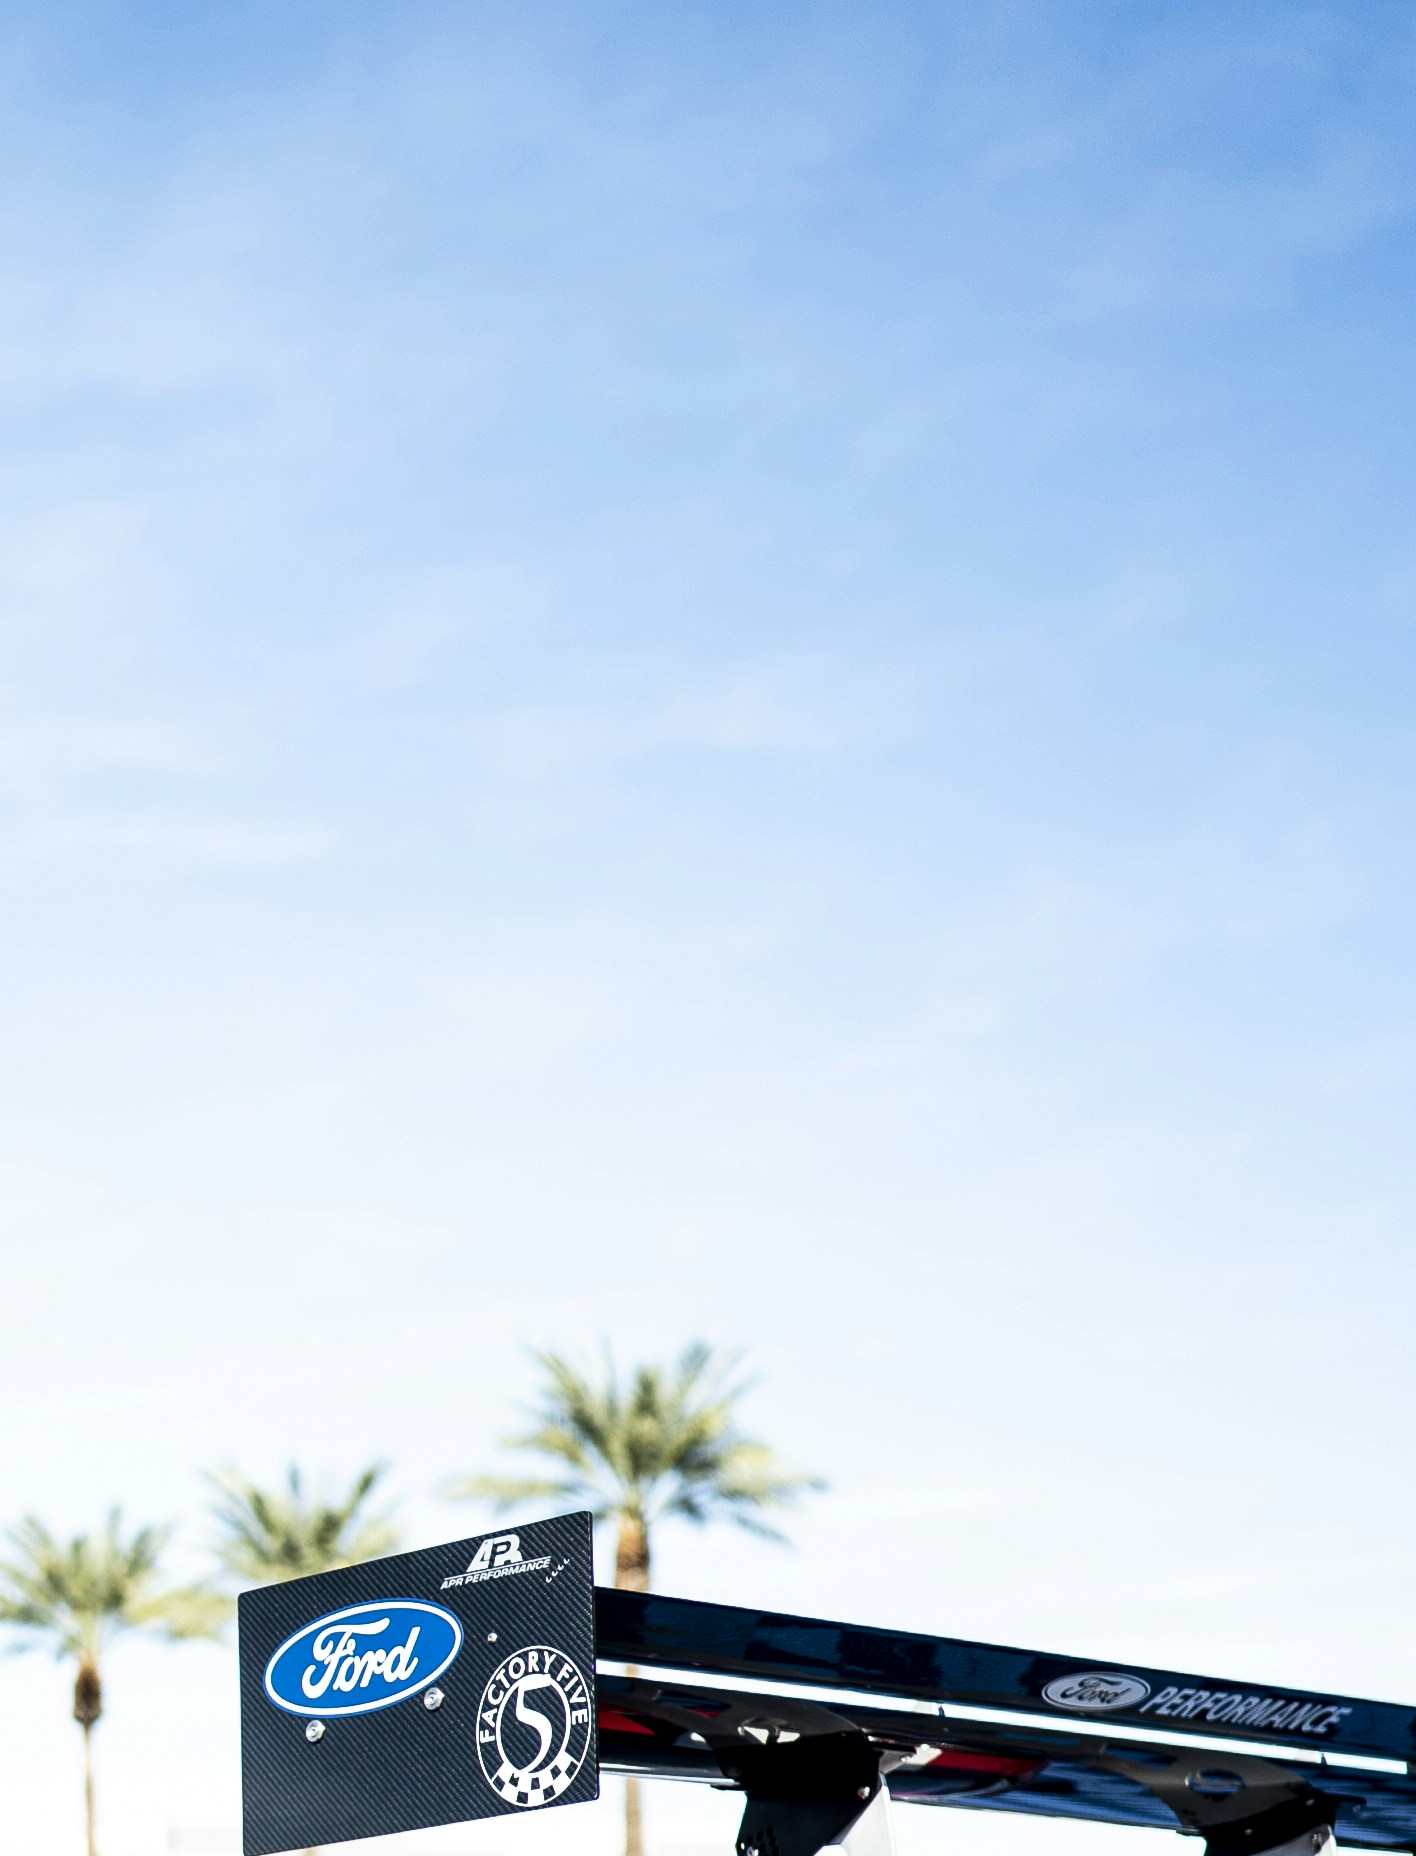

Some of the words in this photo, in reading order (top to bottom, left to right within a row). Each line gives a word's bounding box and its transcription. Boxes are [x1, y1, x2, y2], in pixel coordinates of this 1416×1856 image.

[440, 1578, 464, 1590] APR
[465, 1559, 551, 1585] PERFORMANCE
[301, 1617, 421, 1699] Ford
[480, 1651, 556, 1744] FACTORY
[556, 1663, 589, 1725] FIVE
[1060, 1676, 1133, 1704] Ford
[1139, 1686, 1353, 1734] PERFORMANCE
